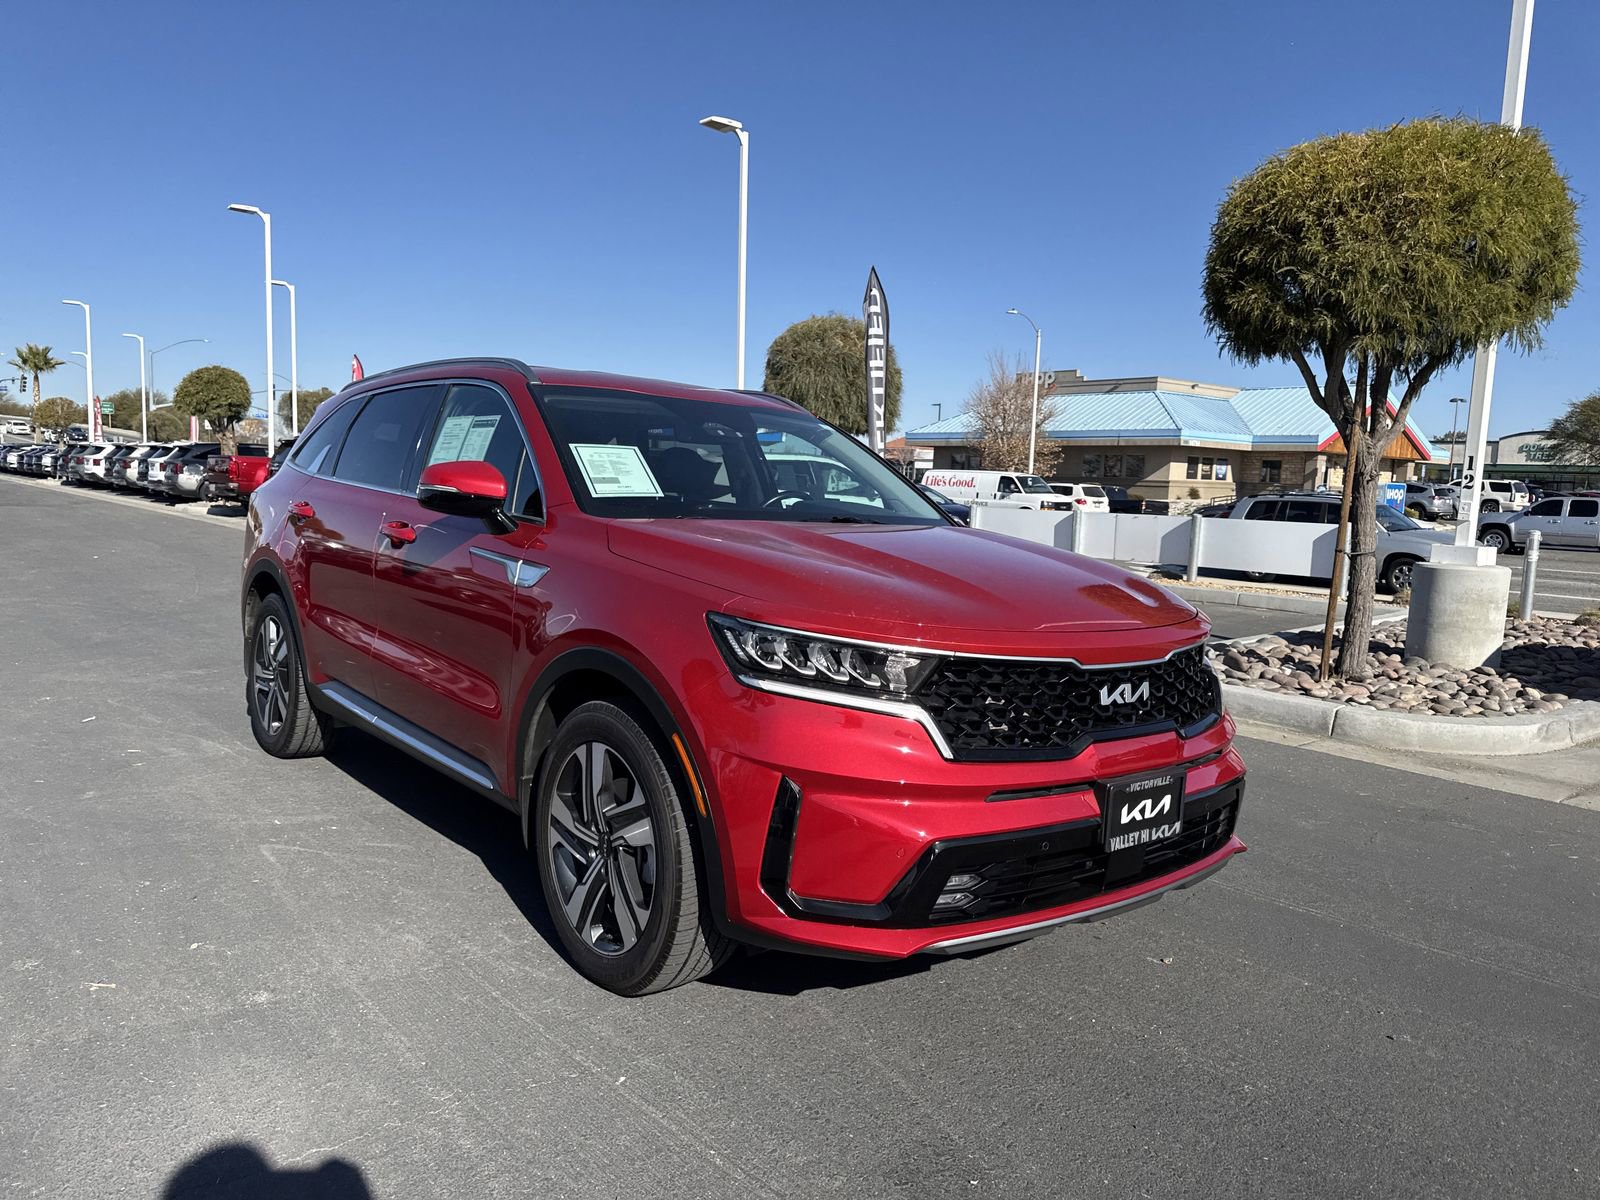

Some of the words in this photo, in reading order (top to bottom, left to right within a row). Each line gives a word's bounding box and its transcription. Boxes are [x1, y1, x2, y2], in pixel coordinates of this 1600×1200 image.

[925, 475, 947, 487] Life's
[948, 476, 976, 488] Good.
[1100, 681, 1150, 706] KIA
[1130, 775, 1171, 792] VICTORVILLE
[1120, 794, 1172, 825] KIA
[1110, 831, 1139, 853] VALLEY
[1141, 827, 1150, 844] HI
[1151, 820, 1181, 841] KIA
